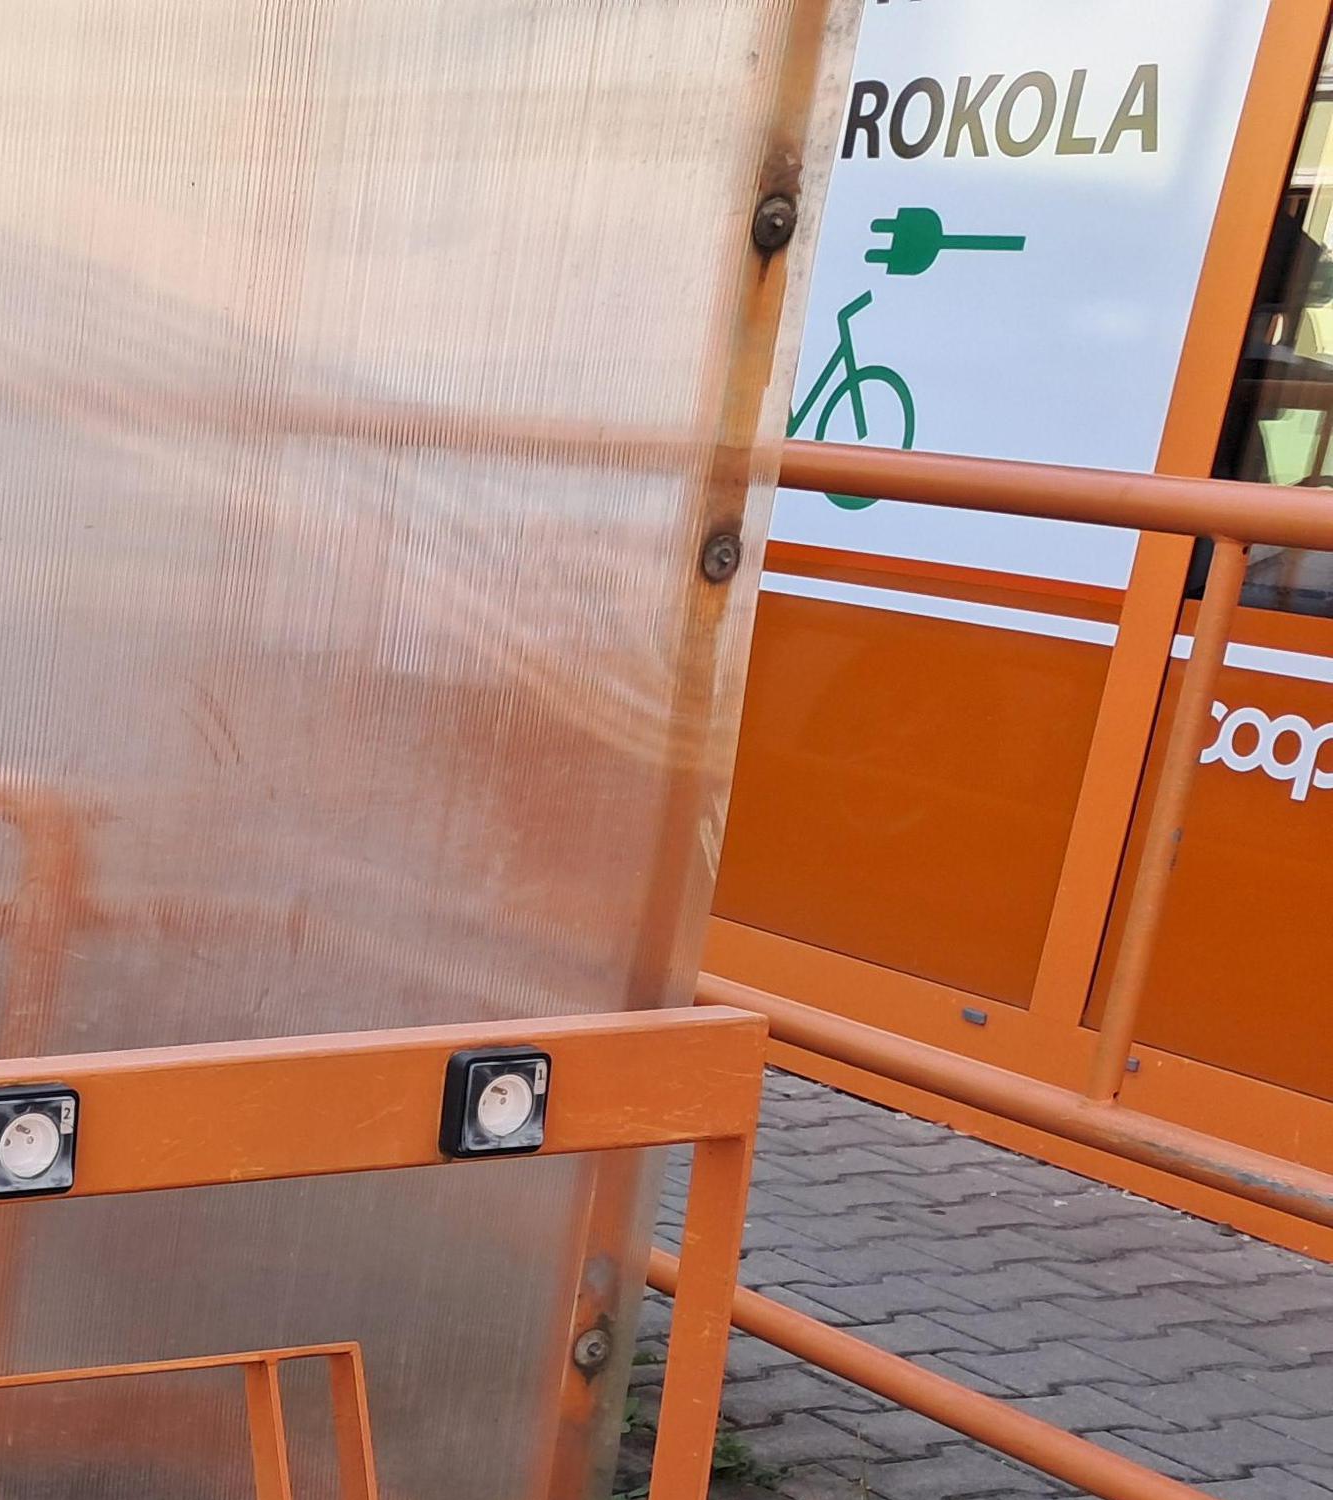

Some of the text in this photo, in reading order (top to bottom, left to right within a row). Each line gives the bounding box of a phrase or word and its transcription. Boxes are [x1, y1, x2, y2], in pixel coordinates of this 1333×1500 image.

[841, 64, 1159, 160] ROKOLA
[538, 1069, 544, 1080] 1
[63, 1107, 71, 1119] 2
